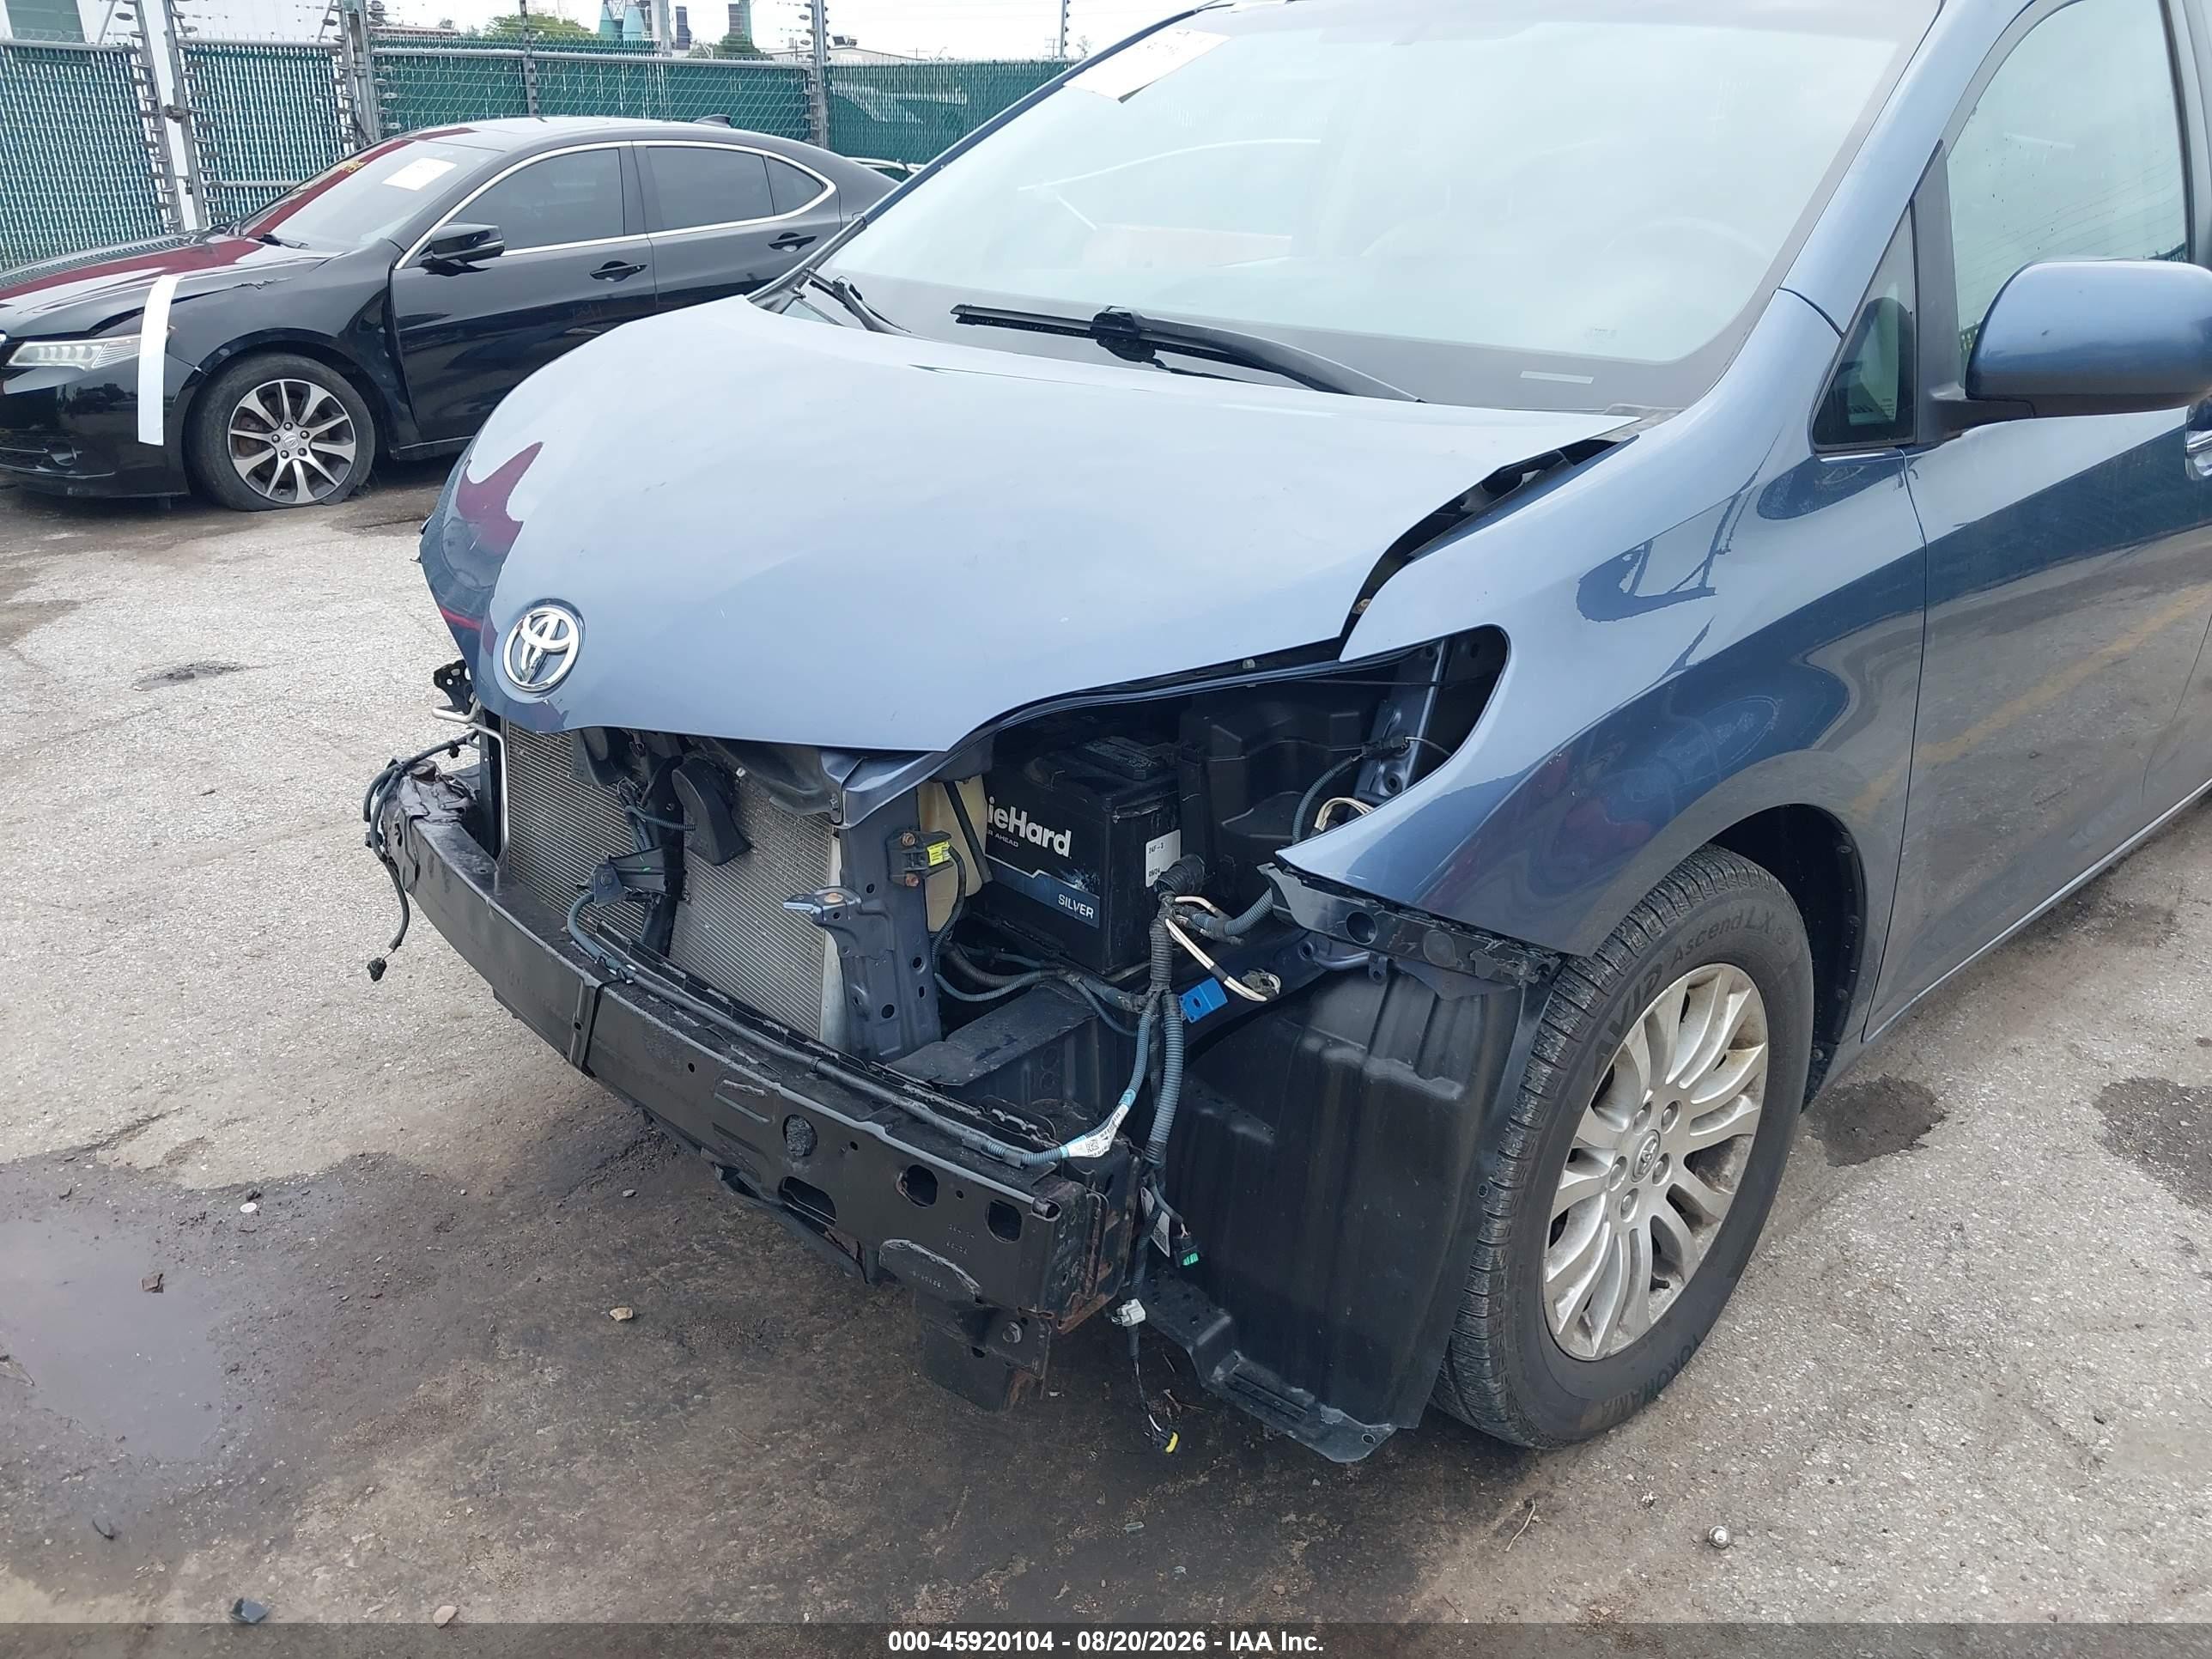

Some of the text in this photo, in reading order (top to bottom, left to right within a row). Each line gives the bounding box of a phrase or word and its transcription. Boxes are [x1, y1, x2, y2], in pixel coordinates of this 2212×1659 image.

[995, 833, 1018, 848] AHEAD
[1057, 894, 1094, 920] SILVER
[1668, 908, 1744, 970] Ascend
[1744, 906, 1777, 934] LX
